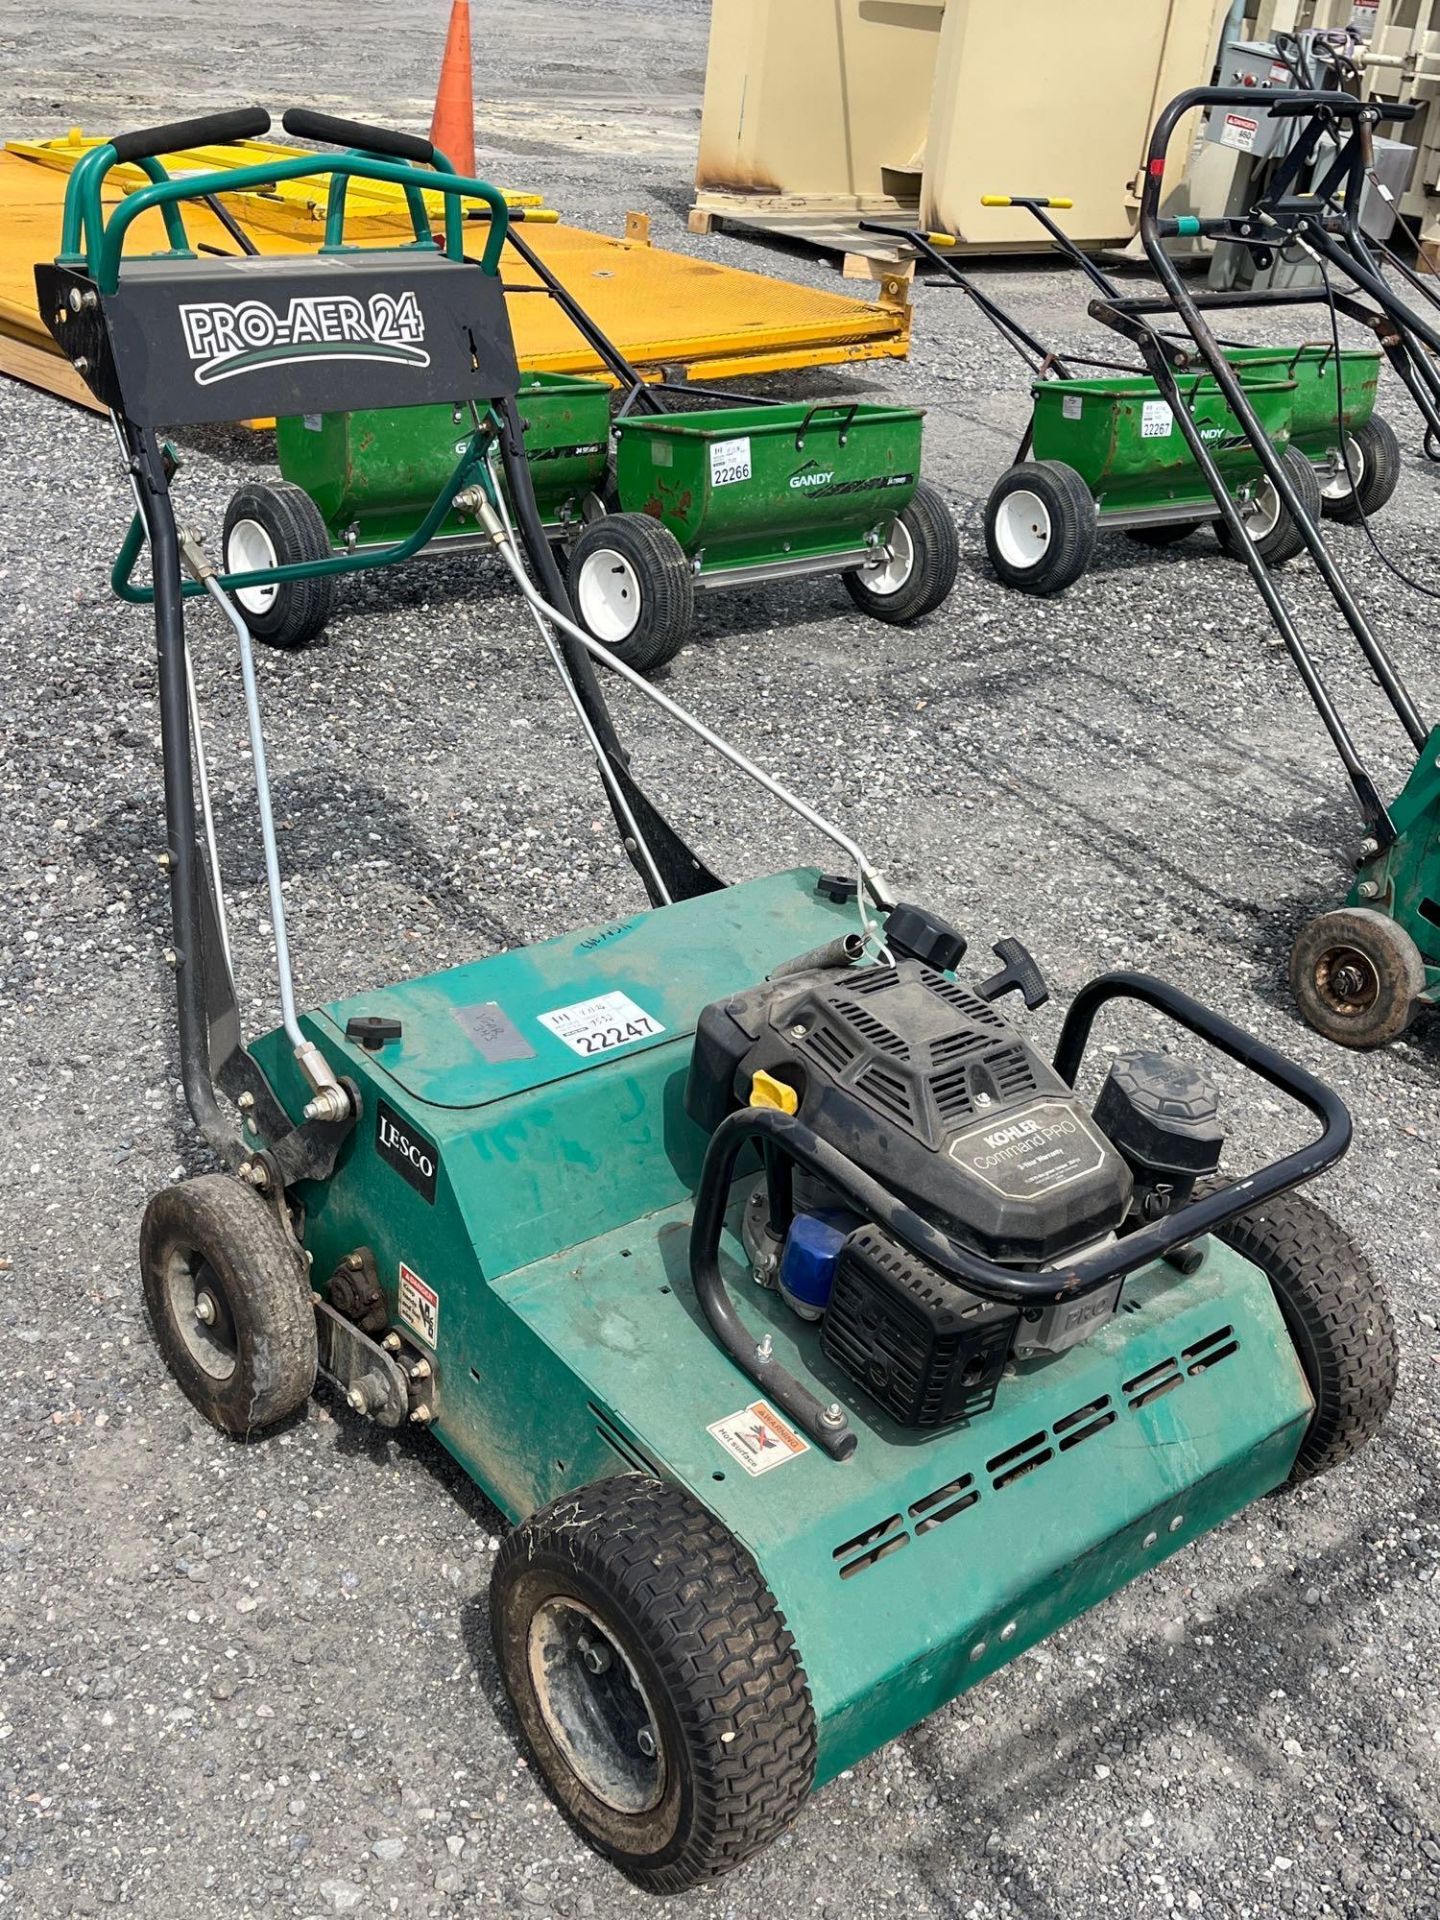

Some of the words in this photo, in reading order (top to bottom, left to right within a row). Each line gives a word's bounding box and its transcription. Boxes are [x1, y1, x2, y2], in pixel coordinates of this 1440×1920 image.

[181, 298, 371, 357] PRO-AER
[370, 293, 424, 341] 24
[1144, 423, 1170, 436] 22267
[1200, 428, 1225, 440] NDY
[714, 464, 749, 485] 22266
[789, 471, 834, 488] GANDY
[576, 1017, 654, 1053] 22247
[379, 1115, 433, 1178] LESCO
[973, 1134, 1046, 1170] Command
[1042, 1120, 1076, 1142] PRO
[983, 1119, 1042, 1149] KOHLER
[717, 1428, 733, 1442] Hot
[729, 1440, 759, 1467] surface
[761, 1413, 800, 1448] WARNING
